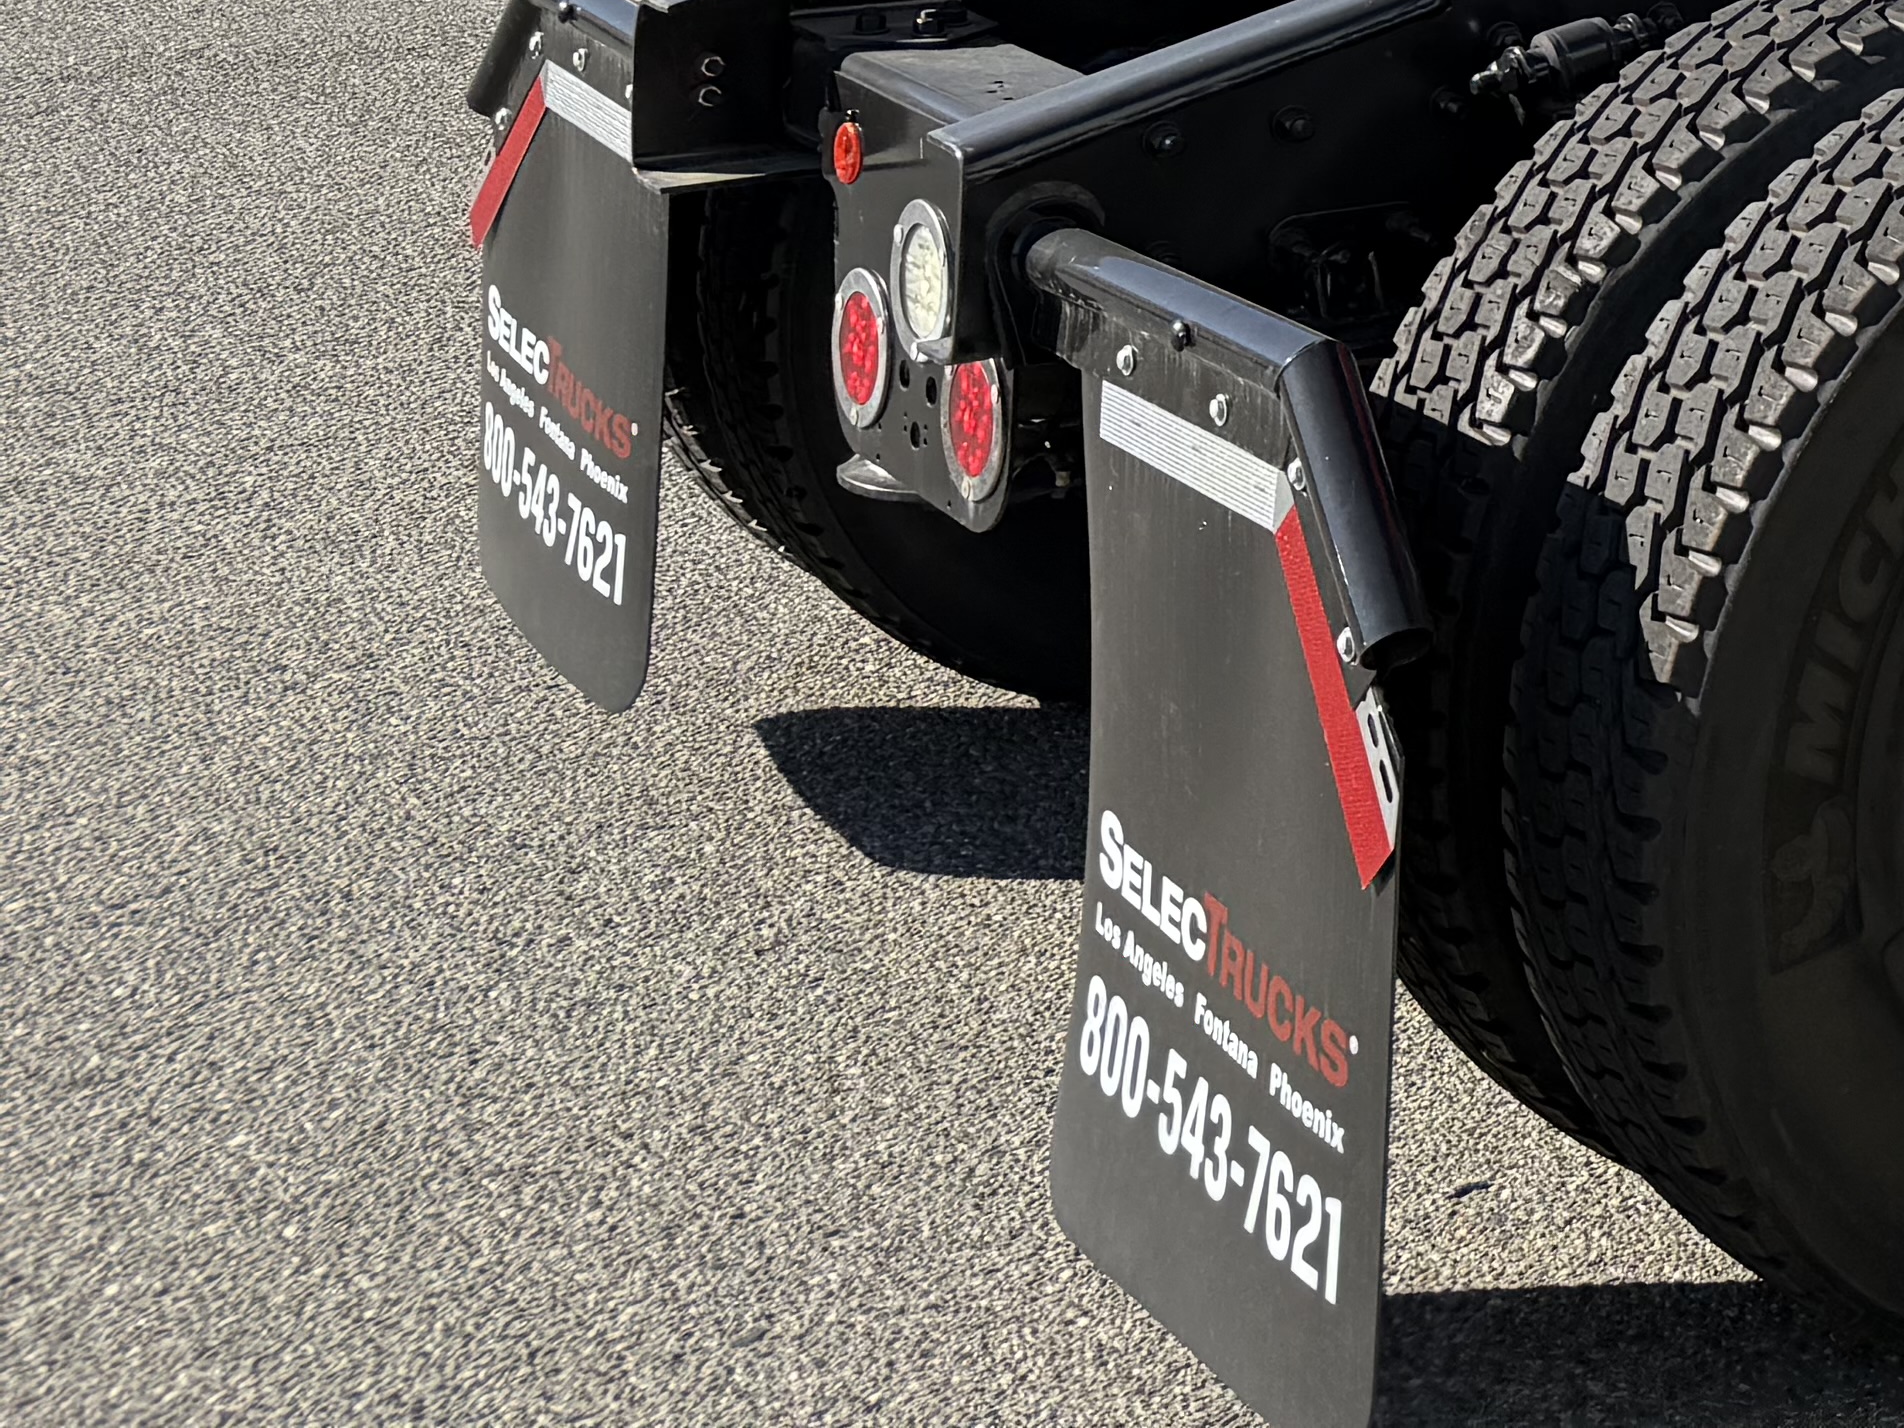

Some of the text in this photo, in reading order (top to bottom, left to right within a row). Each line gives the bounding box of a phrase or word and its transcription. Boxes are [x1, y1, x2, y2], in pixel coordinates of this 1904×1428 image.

[483, 401, 626, 606] 800-543-7621
[539, 406, 576, 461] Fontana
[580, 448, 629, 504] Phoenix
[1079, 975, 1343, 1306] 800-543-7621
[1095, 901, 1345, 1154] Los Angeles Fontana Phoenix
